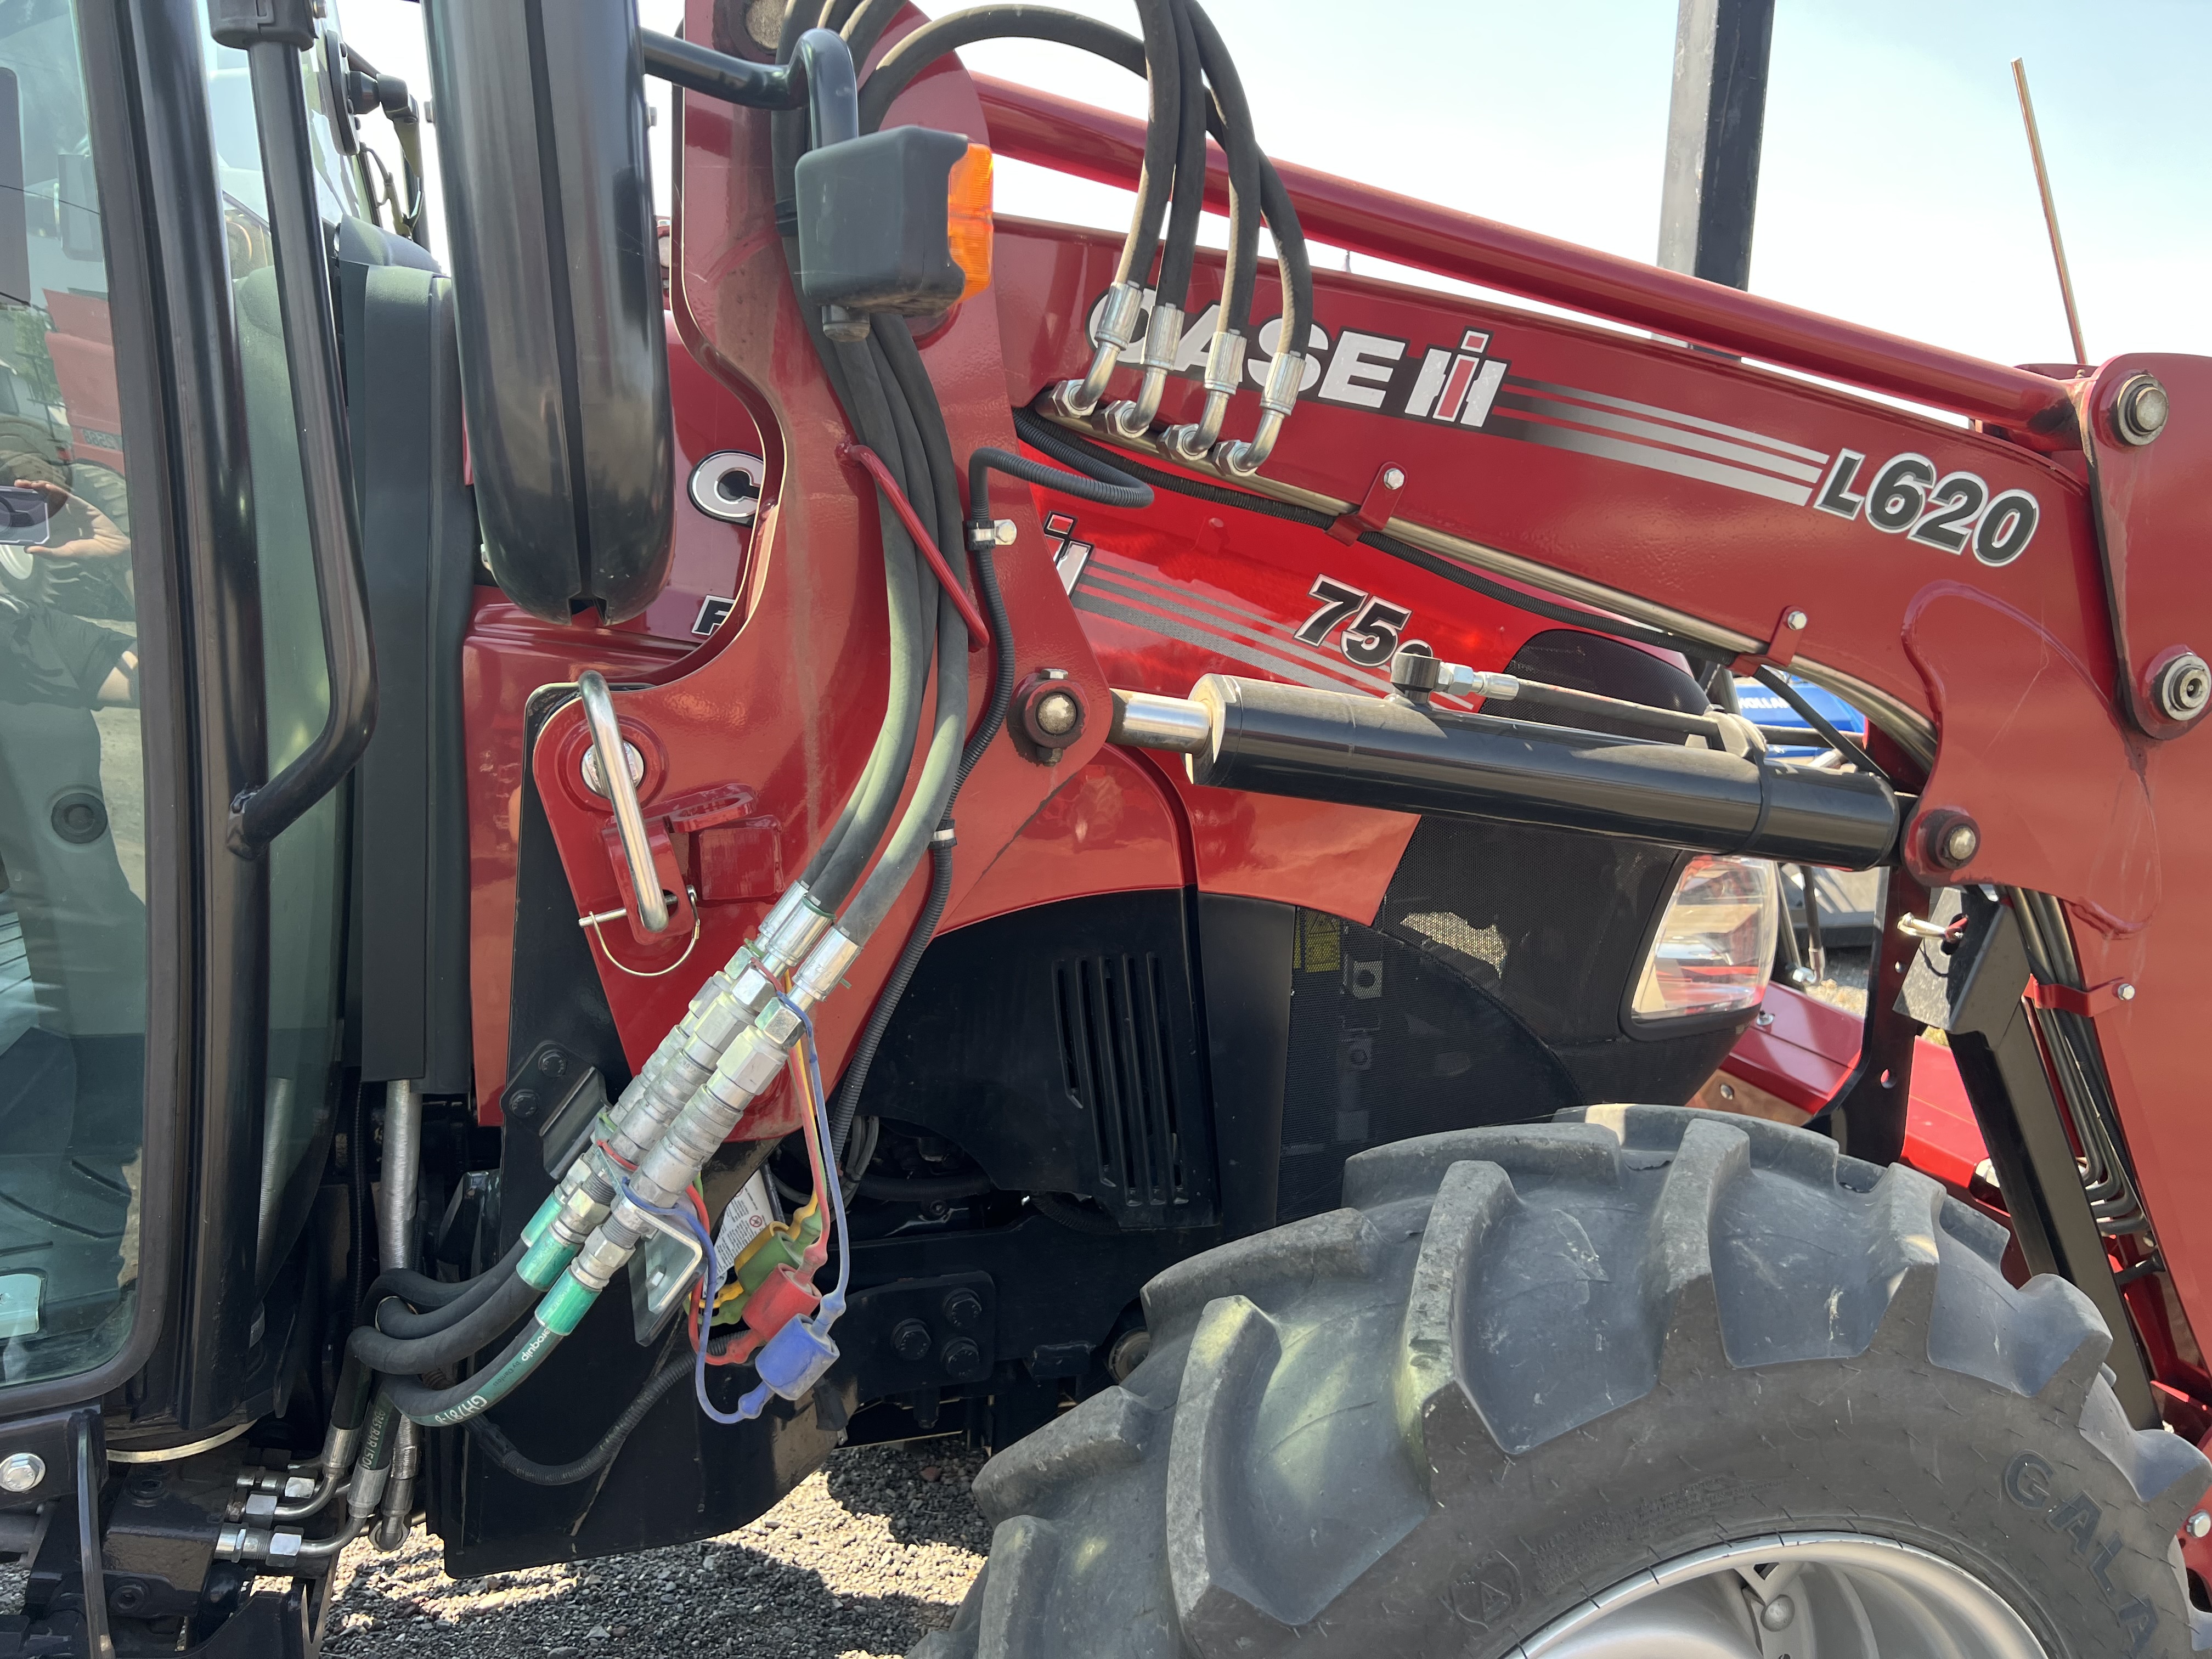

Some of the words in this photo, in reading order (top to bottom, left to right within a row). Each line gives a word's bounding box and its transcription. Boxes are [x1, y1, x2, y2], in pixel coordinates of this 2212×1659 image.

[1813, 448, 2040, 567] L620
[1293, 573, 1434, 668] 75
[1739, 697, 1790, 709] HOLLAN
[521, 1327, 551, 1362] eroquip
[435, 1395, 488, 1425] GH781-8
[366, 1426, 380, 1448] BAR
